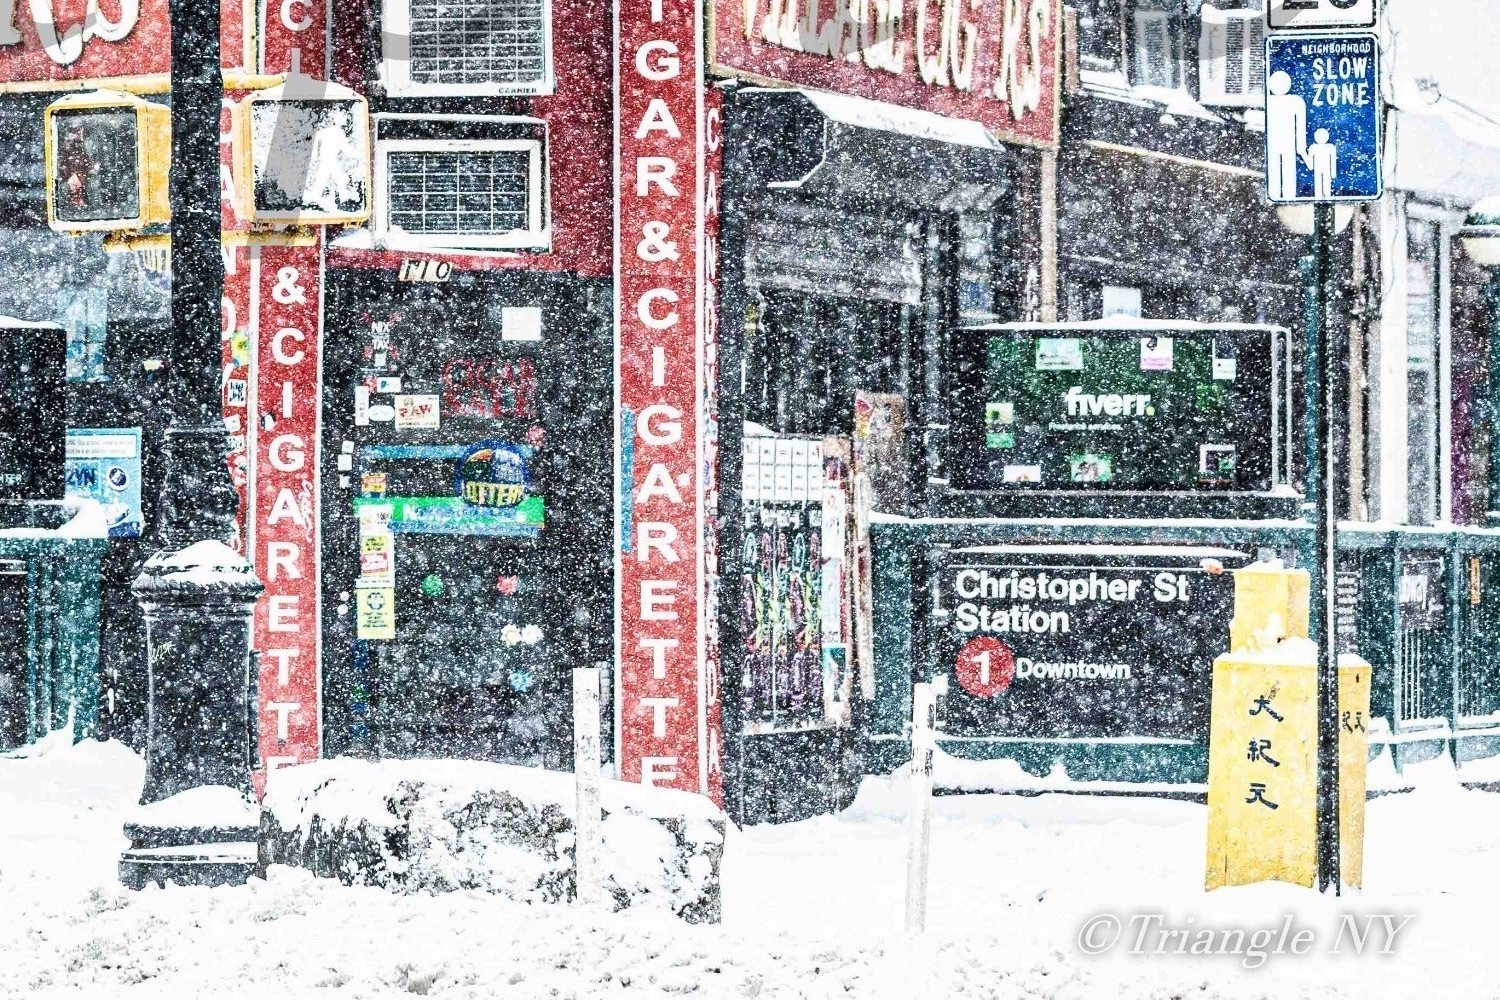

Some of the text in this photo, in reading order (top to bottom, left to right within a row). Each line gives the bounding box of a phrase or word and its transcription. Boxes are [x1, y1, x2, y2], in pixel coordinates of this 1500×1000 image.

[1301, 43, 1371, 56] NEIGHBORHOOD
[1312, 57, 1368, 81] SLOW
[1312, 83, 1369, 106] ZONE
[955, 569, 1191, 606] Christopher St
[955, 602, 1070, 633] Station
[970, 650, 1132, 686] 1 Downtown
[1245, 694, 1284, 810] 大紀元
